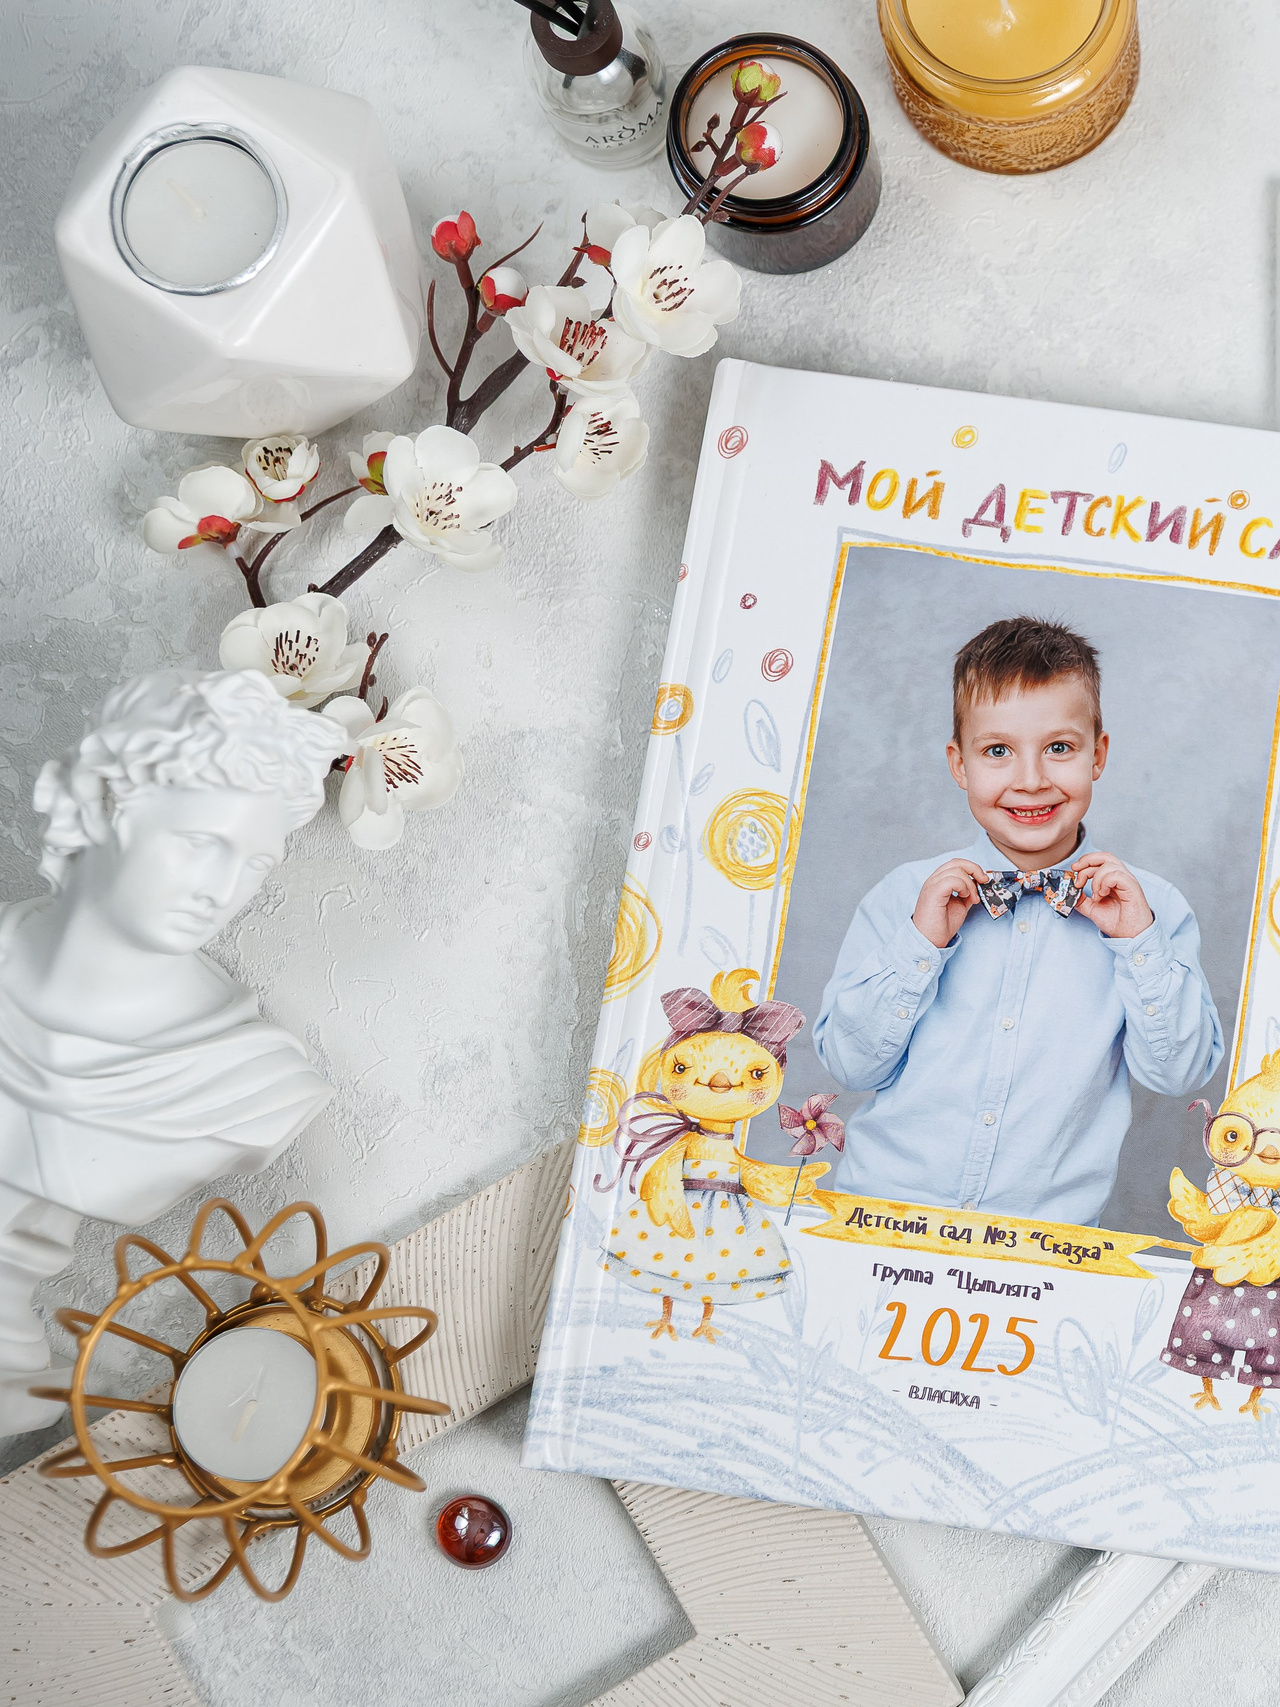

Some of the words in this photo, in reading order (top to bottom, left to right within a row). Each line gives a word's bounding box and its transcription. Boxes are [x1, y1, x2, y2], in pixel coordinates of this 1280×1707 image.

[813, 459, 946, 520] МОЙ
[961, 482, 1226, 556] ДЕТСКИЙ
[845, 1207, 928, 1236] Детский
[939, 1224, 972, 1244] сад
[984, 1225, 1017, 1248] №3
[1030, 1231, 1114, 1265] “Сказка”
[872, 1263, 934, 1286] группа
[947, 1268, 1054, 1301] “Цыплята”
[877, 1301, 1039, 1376] 2025
[908, 1384, 981, 1410] ВЛАСИХА
